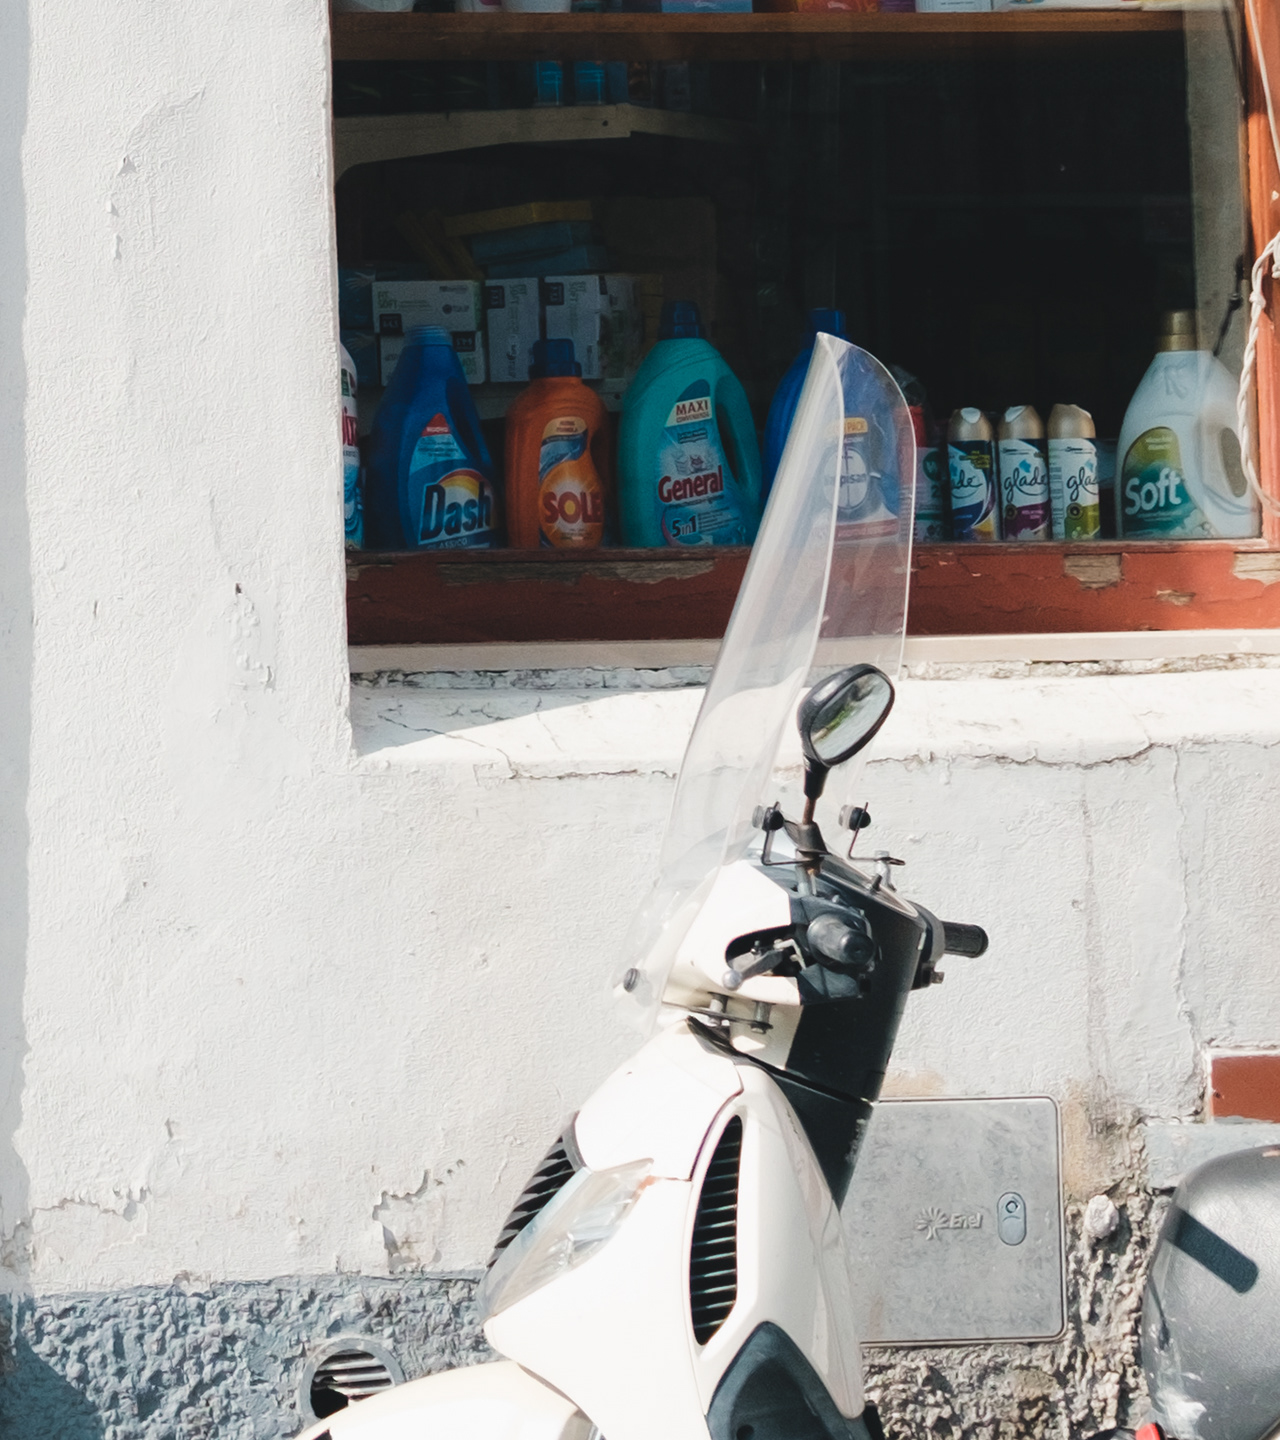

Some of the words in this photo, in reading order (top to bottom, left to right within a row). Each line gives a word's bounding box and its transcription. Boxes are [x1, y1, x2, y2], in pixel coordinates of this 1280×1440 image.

[676, 399, 708, 416] MAXI
[658, 464, 724, 503] General
[1125, 467, 1182, 515] Soft
[420, 481, 491, 541] Dash
[543, 491, 602, 524] SOLE
[949, 1212, 984, 1230] Enel
